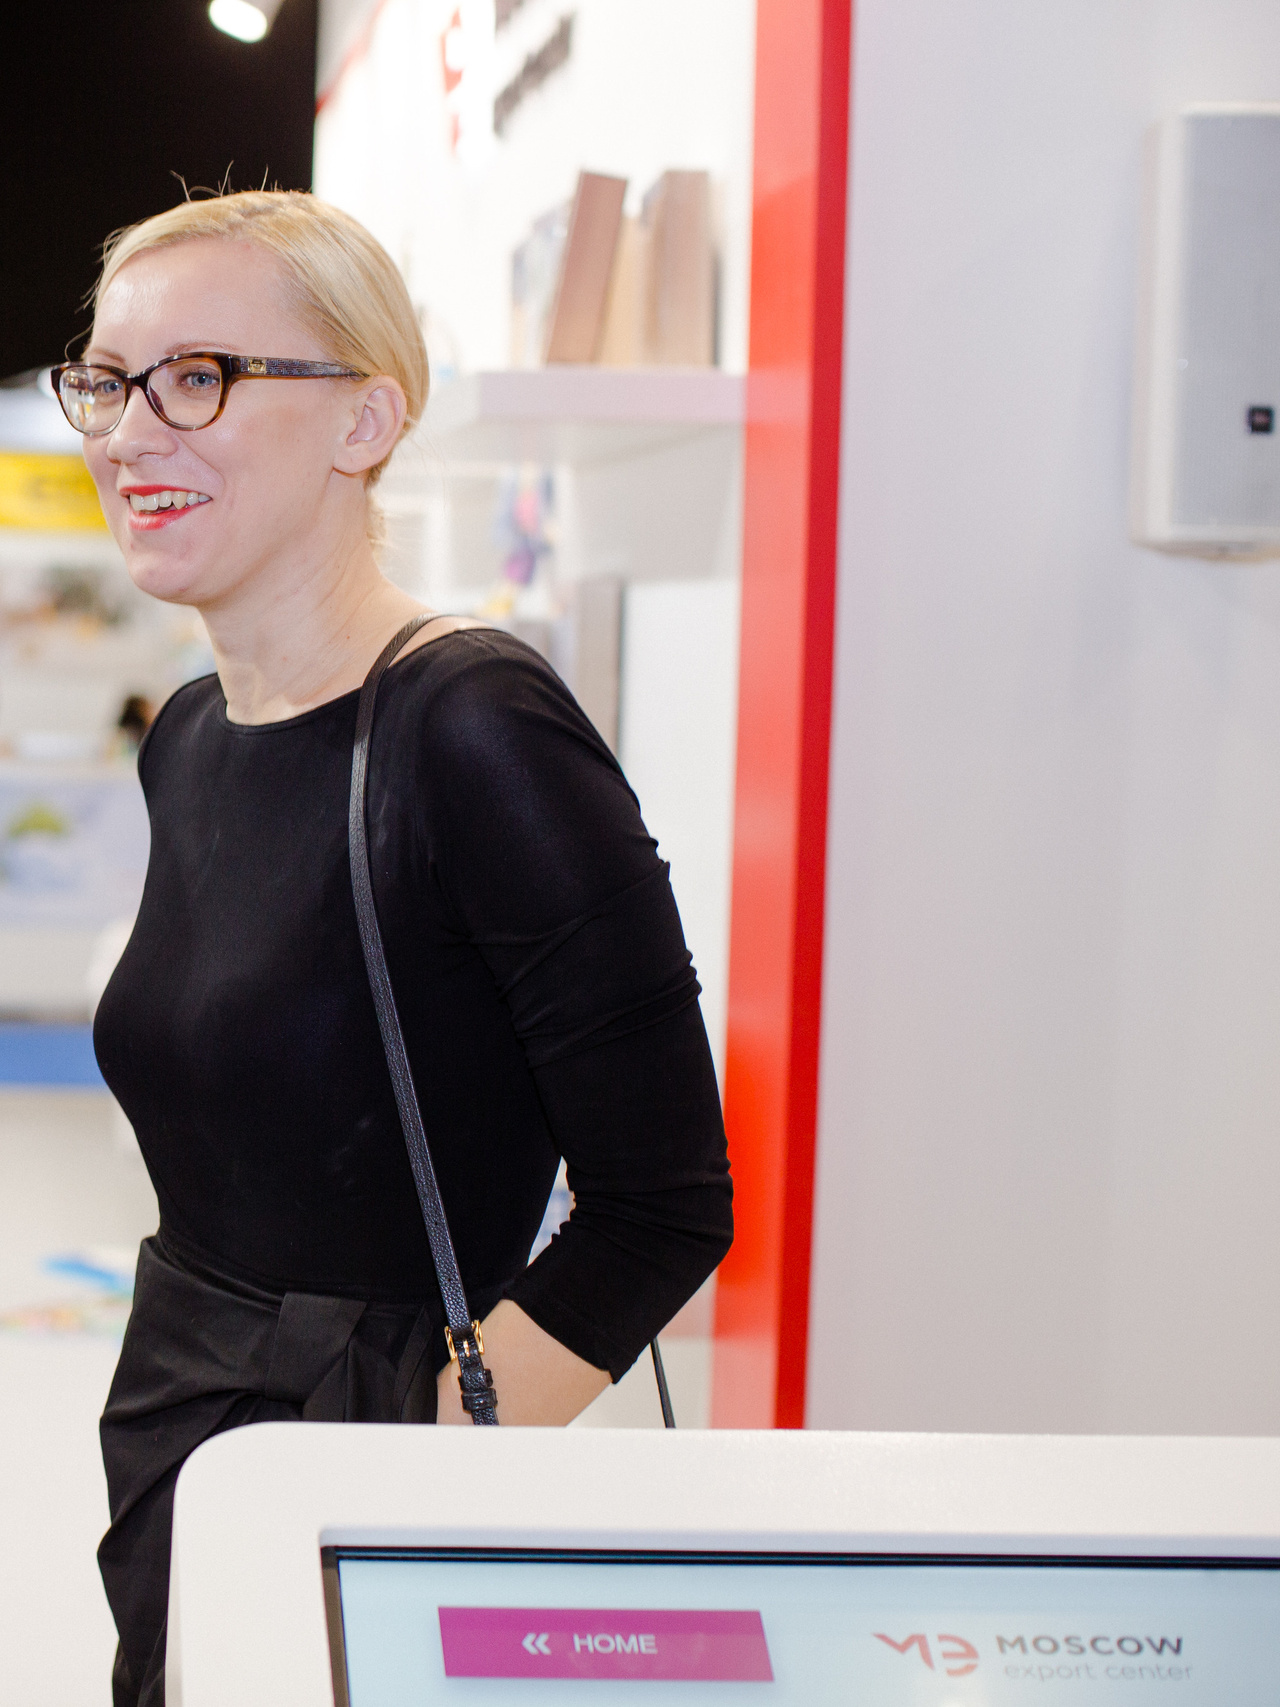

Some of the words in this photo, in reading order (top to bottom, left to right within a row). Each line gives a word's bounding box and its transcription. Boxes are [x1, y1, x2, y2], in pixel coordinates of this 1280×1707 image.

[573, 1633, 658, 1654] HOME
[995, 1635, 1183, 1656] MOSCOW
[1005, 1662, 1094, 1682] export
[1106, 1662, 1194, 1681] center
